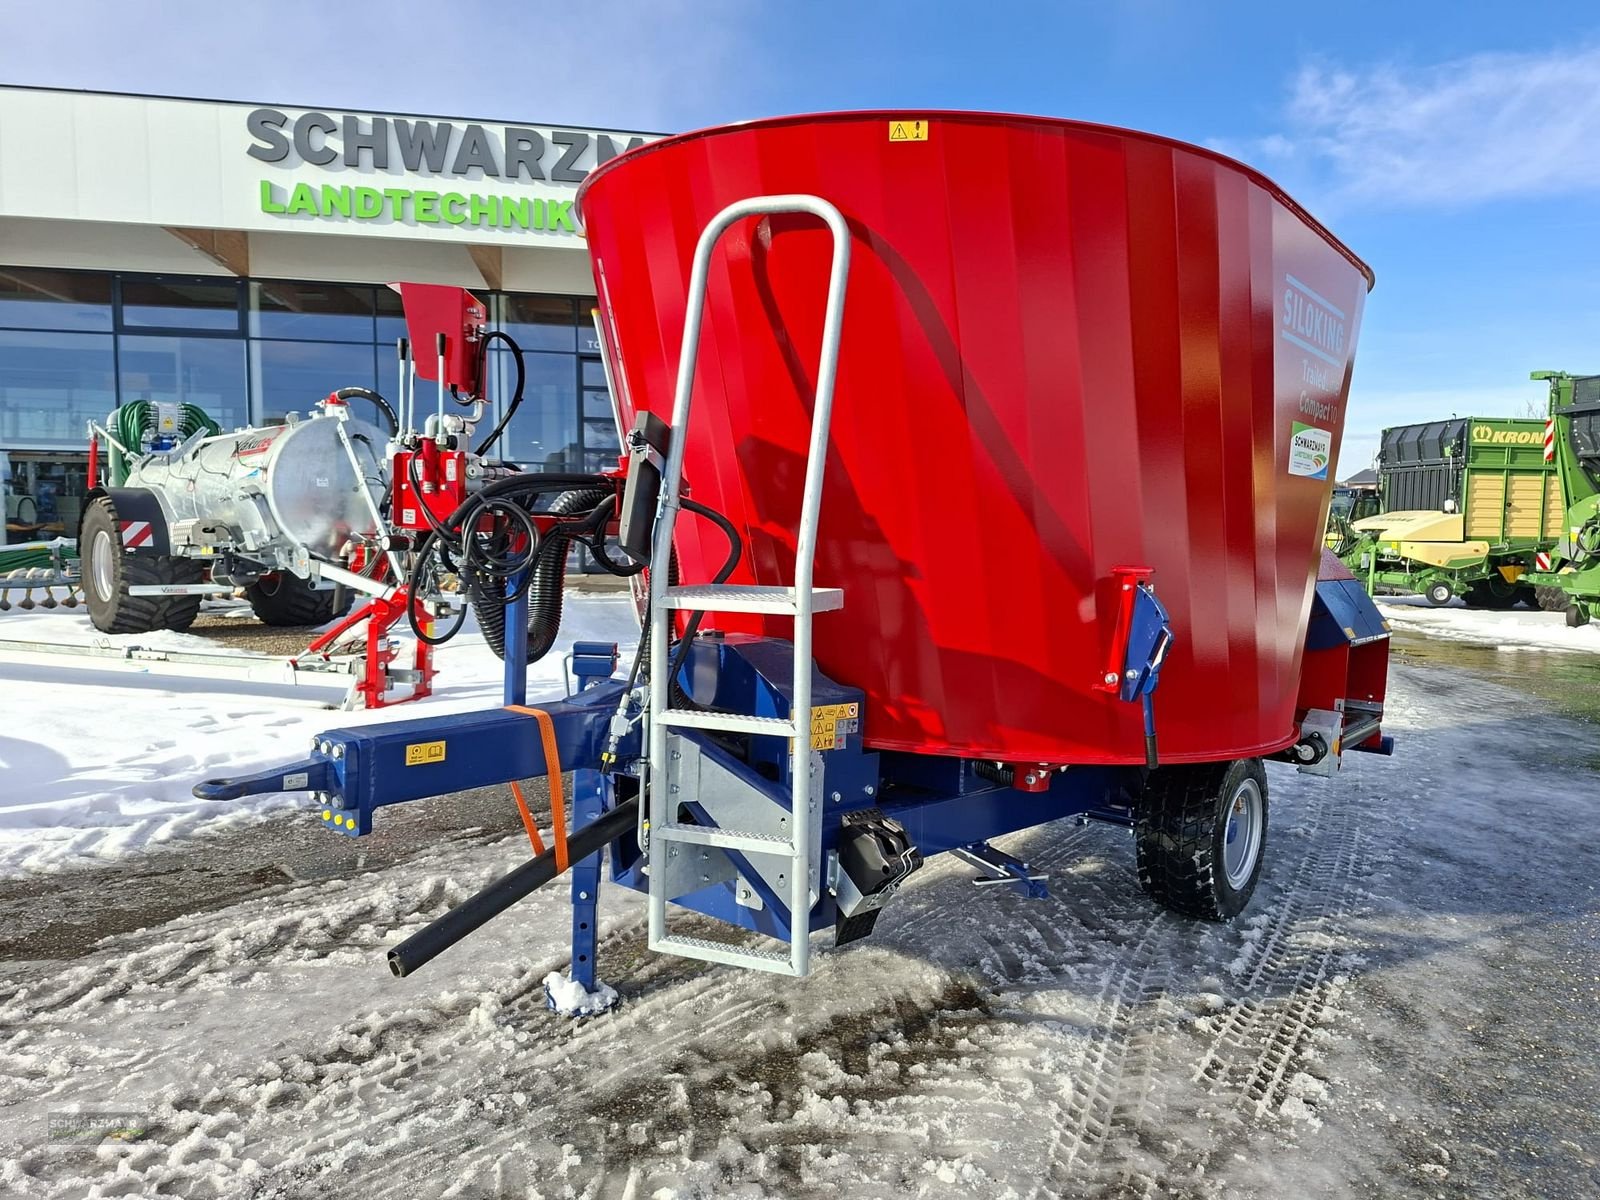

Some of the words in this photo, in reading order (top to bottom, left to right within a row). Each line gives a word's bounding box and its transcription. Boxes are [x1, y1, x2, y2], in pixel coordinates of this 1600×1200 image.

[260, 180, 576, 233] LANDTECHNIK
[1282, 288, 1345, 354] SILOKING
[1299, 390, 1331, 424] Compact
[1492, 431, 1546, 444] KRON
